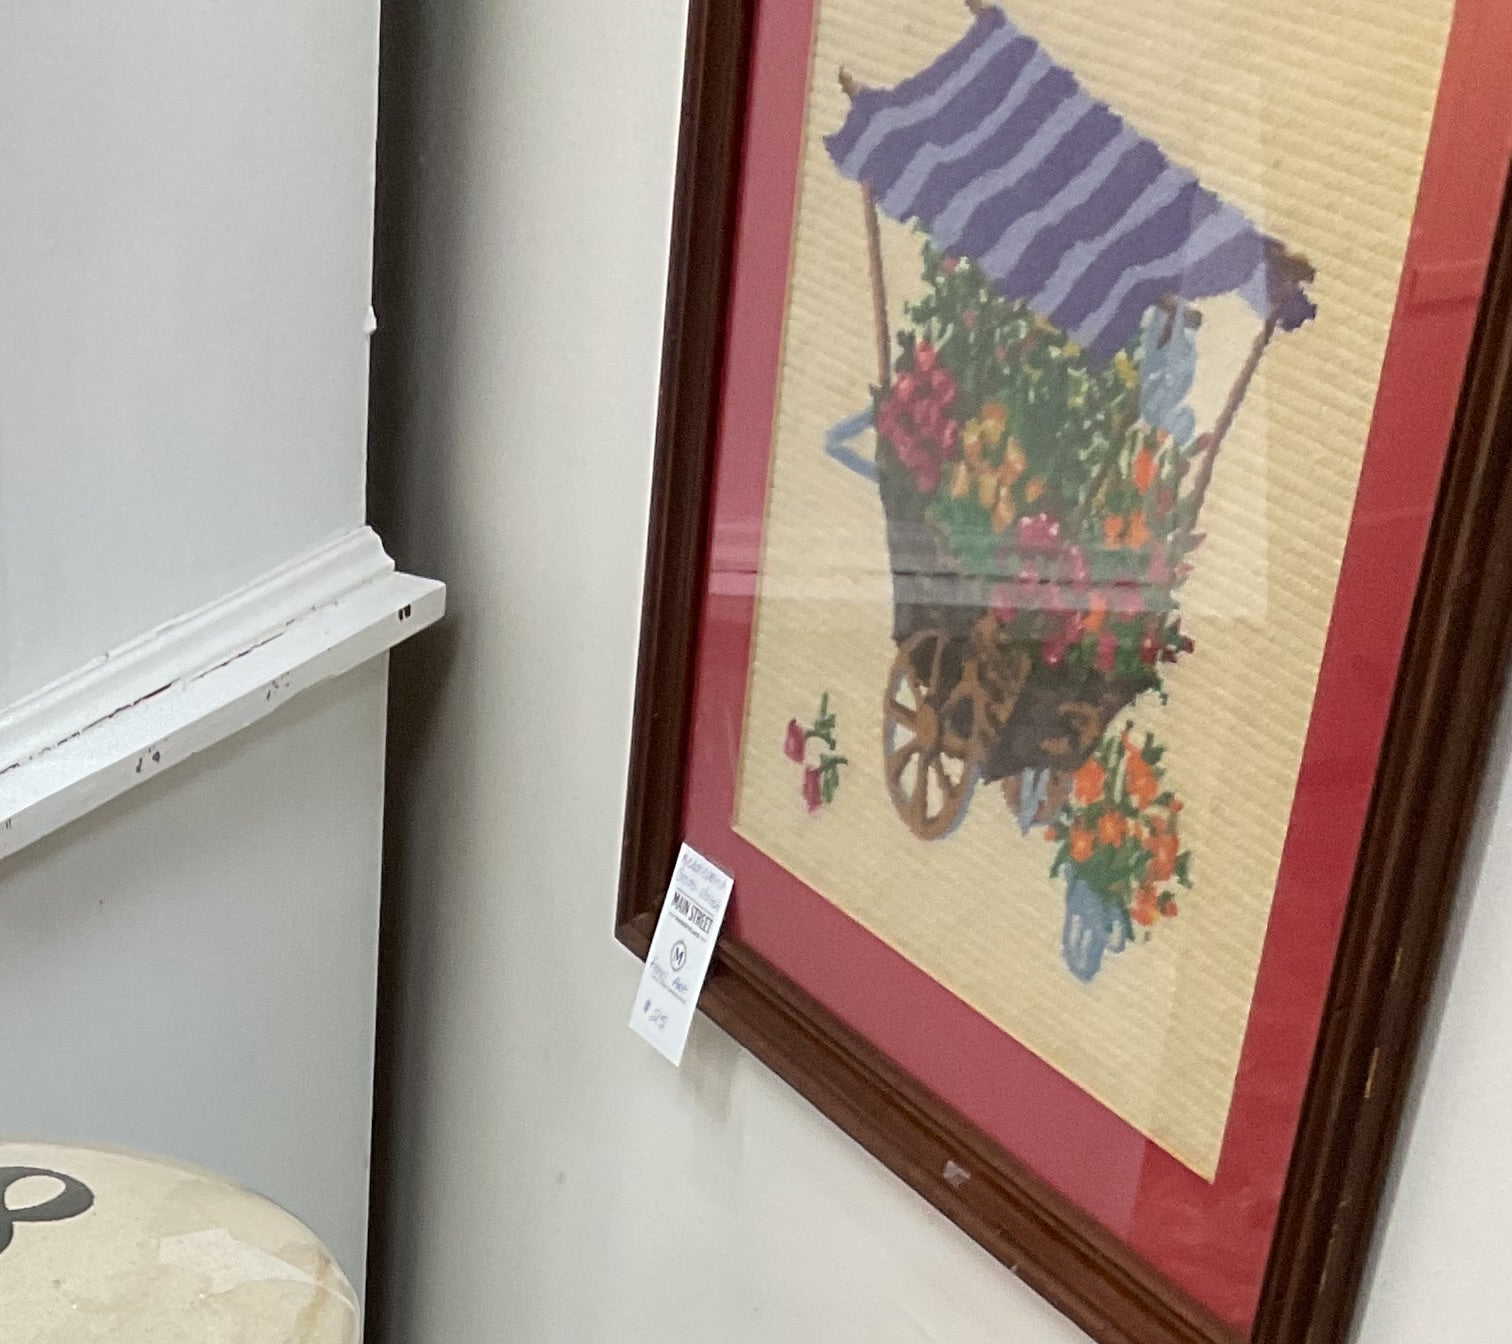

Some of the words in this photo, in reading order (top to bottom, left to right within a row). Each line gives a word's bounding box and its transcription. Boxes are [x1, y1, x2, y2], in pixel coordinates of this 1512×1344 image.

[671, 891, 689, 917] MAIN
[688, 904, 714, 935] STREET
[674, 946, 684, 966] M
